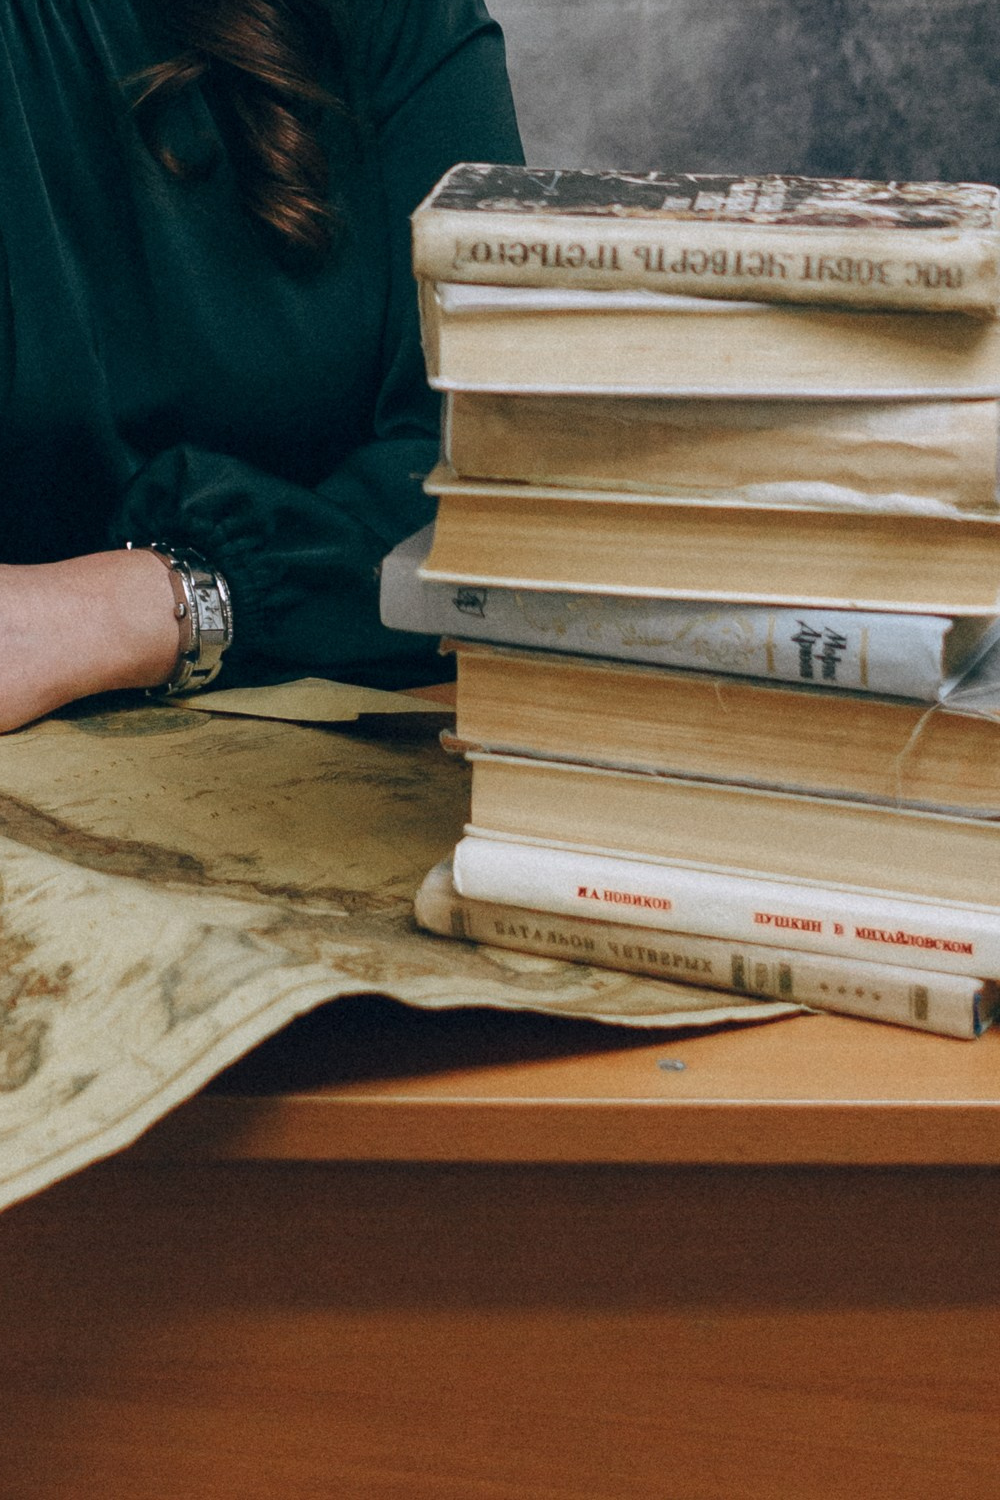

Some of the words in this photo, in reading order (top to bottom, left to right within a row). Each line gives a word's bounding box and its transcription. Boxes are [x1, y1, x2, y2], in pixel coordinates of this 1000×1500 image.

[603, 890, 673, 912] НОВИКОВ
[753, 911, 823, 933] ПУШКИН
[833, 921, 845, 936] В
[854, 925, 974, 957] МИХАЙЛОВСКОМ
[606, 940, 715, 975] ЧЕТВЕРЫХ
